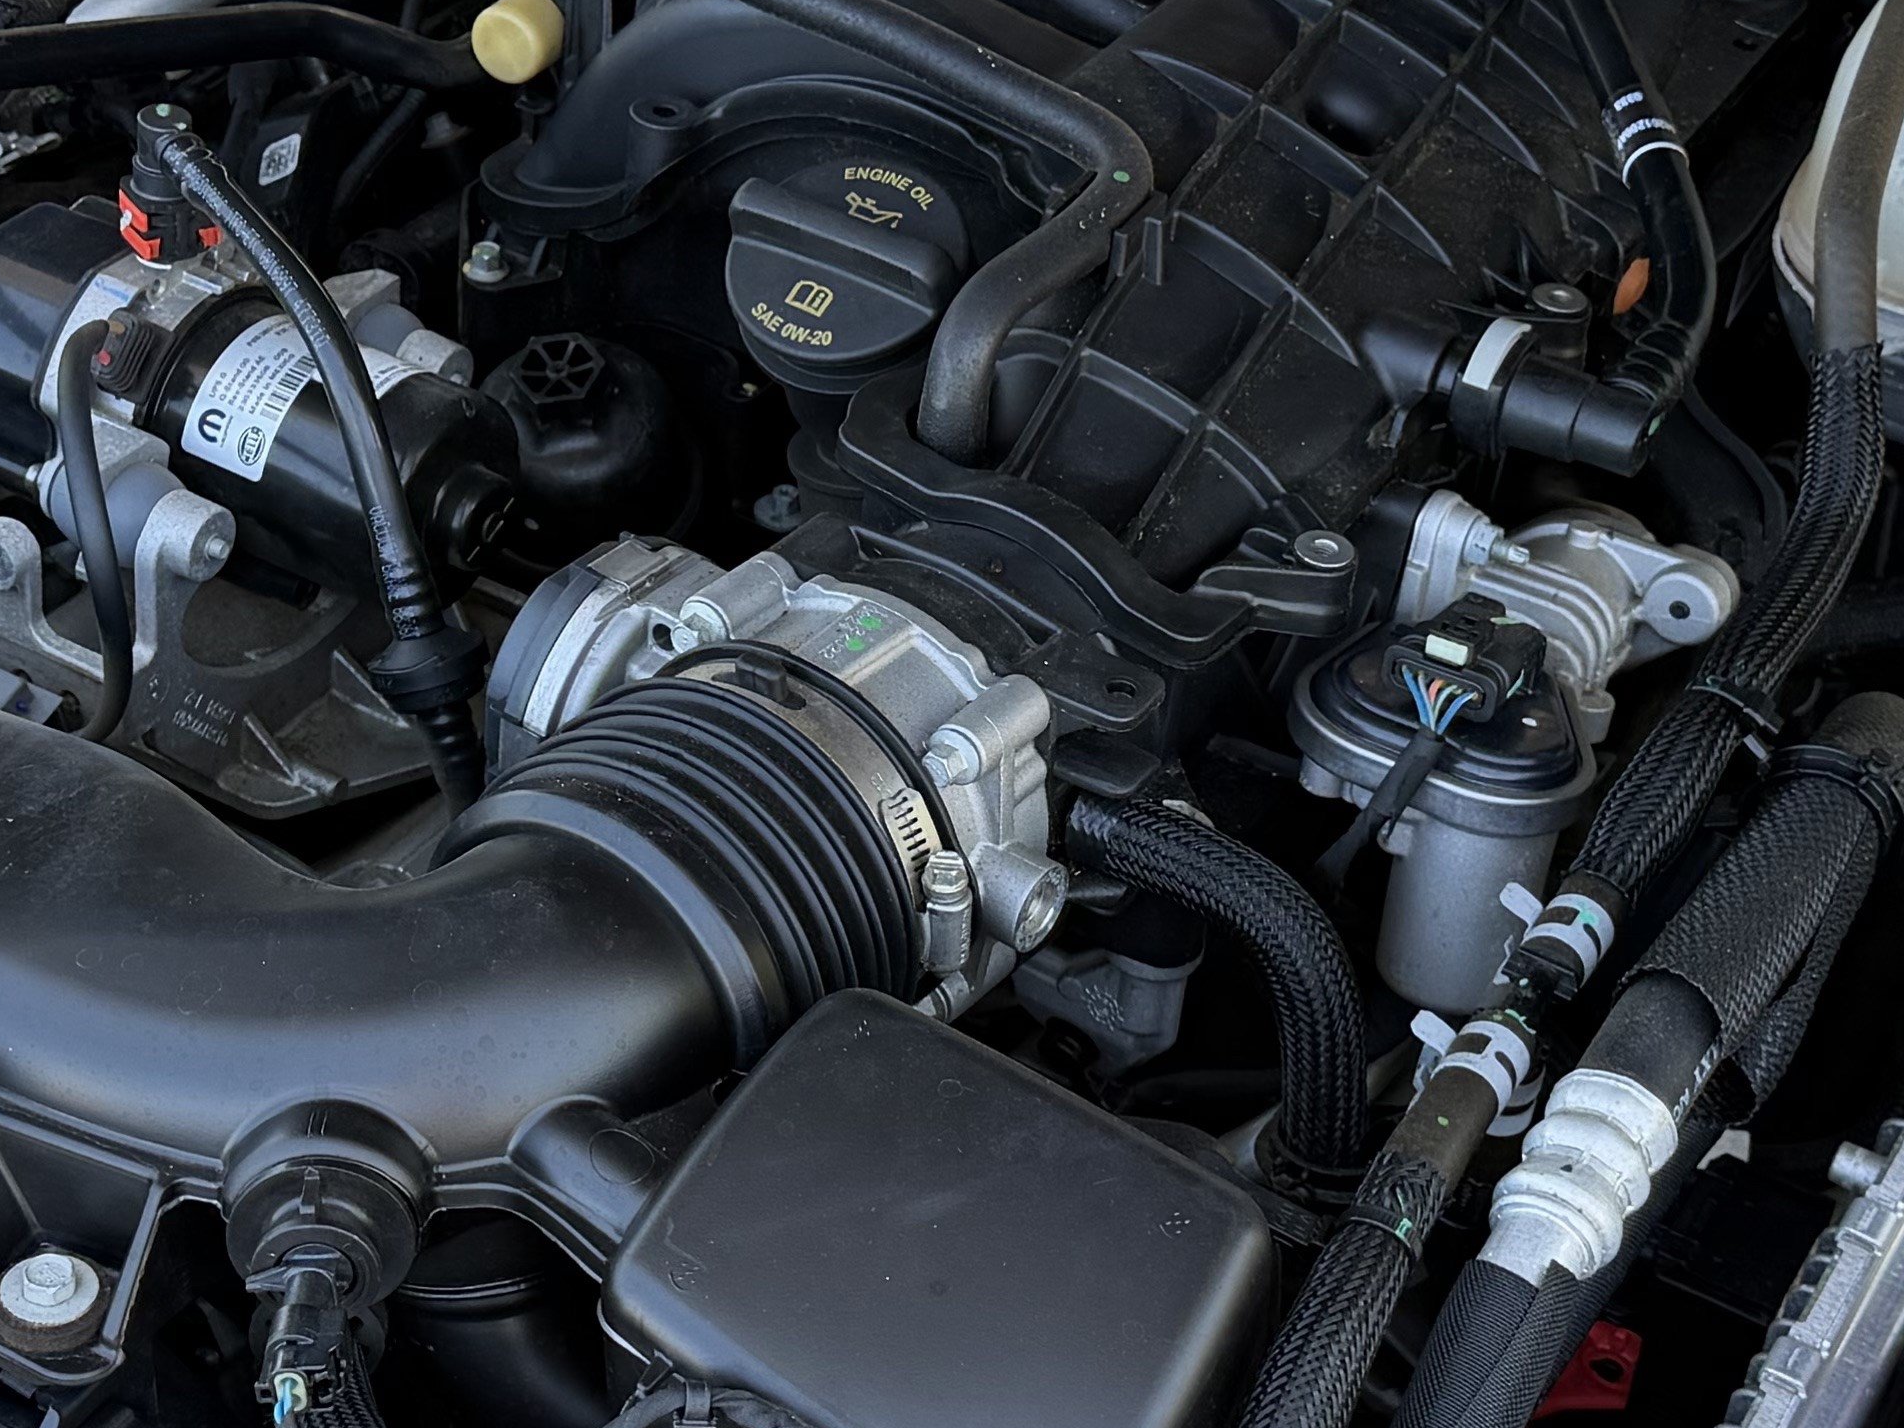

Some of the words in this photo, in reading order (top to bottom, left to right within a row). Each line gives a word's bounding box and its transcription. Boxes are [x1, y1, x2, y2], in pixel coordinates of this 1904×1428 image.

[843, 166, 911, 192] ENGINE
[908, 184, 937, 212] OIL
[750, 300, 784, 336] SAE
[779, 323, 833, 348] 0W-20
